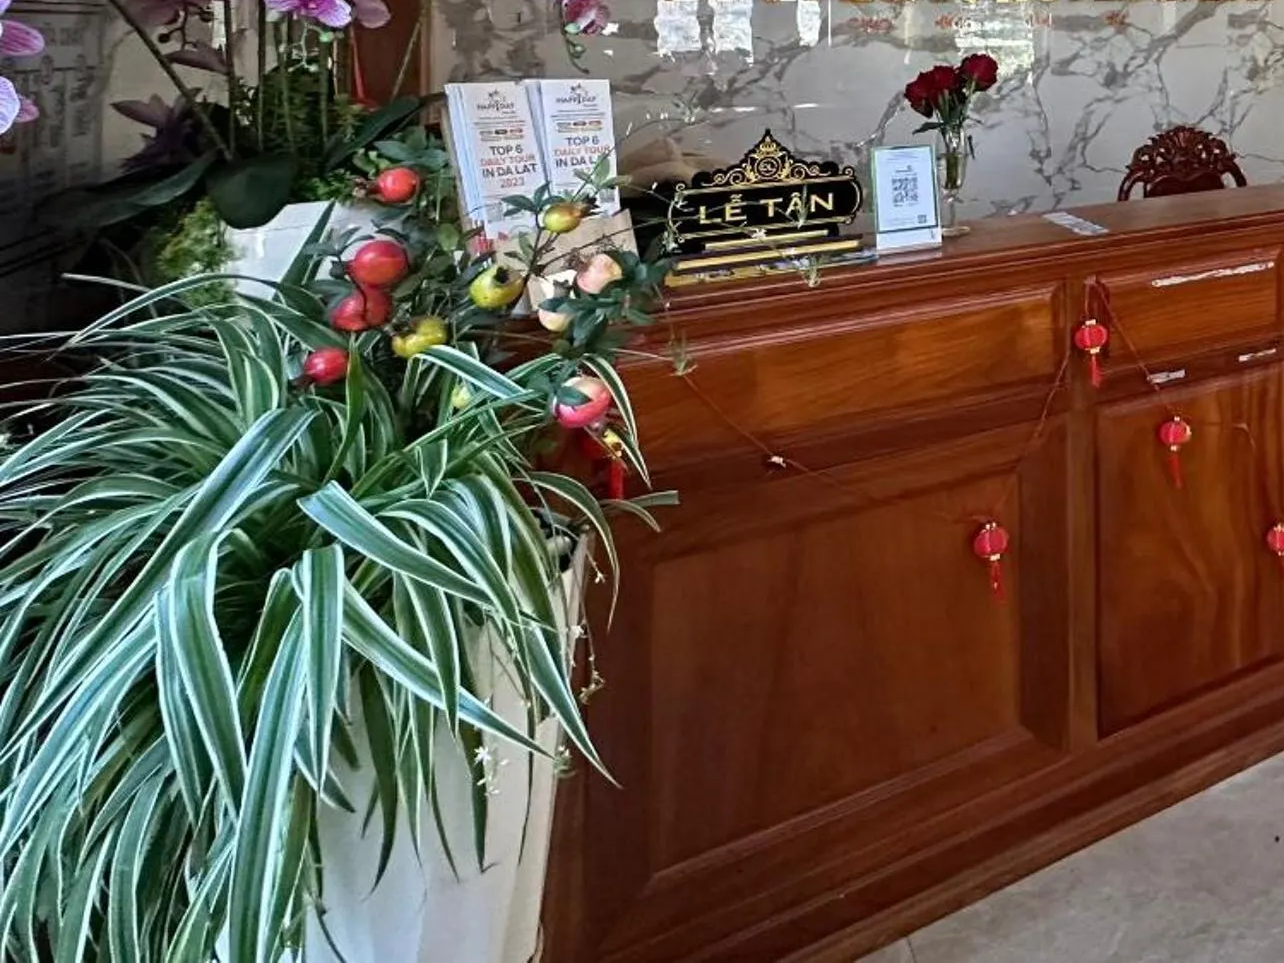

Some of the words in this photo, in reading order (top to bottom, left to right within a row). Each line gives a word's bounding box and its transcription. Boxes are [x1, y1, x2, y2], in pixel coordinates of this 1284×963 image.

[565, 136, 589, 146] TOP
[489, 144, 513, 155] TOP
[515, 144, 523, 154] 6
[555, 158, 567, 168] IN
[482, 168, 494, 178] IN
[515, 163, 538, 174] LAT
[700, 194, 747, 224] LỄ
[760, 192, 834, 218] TÂN
